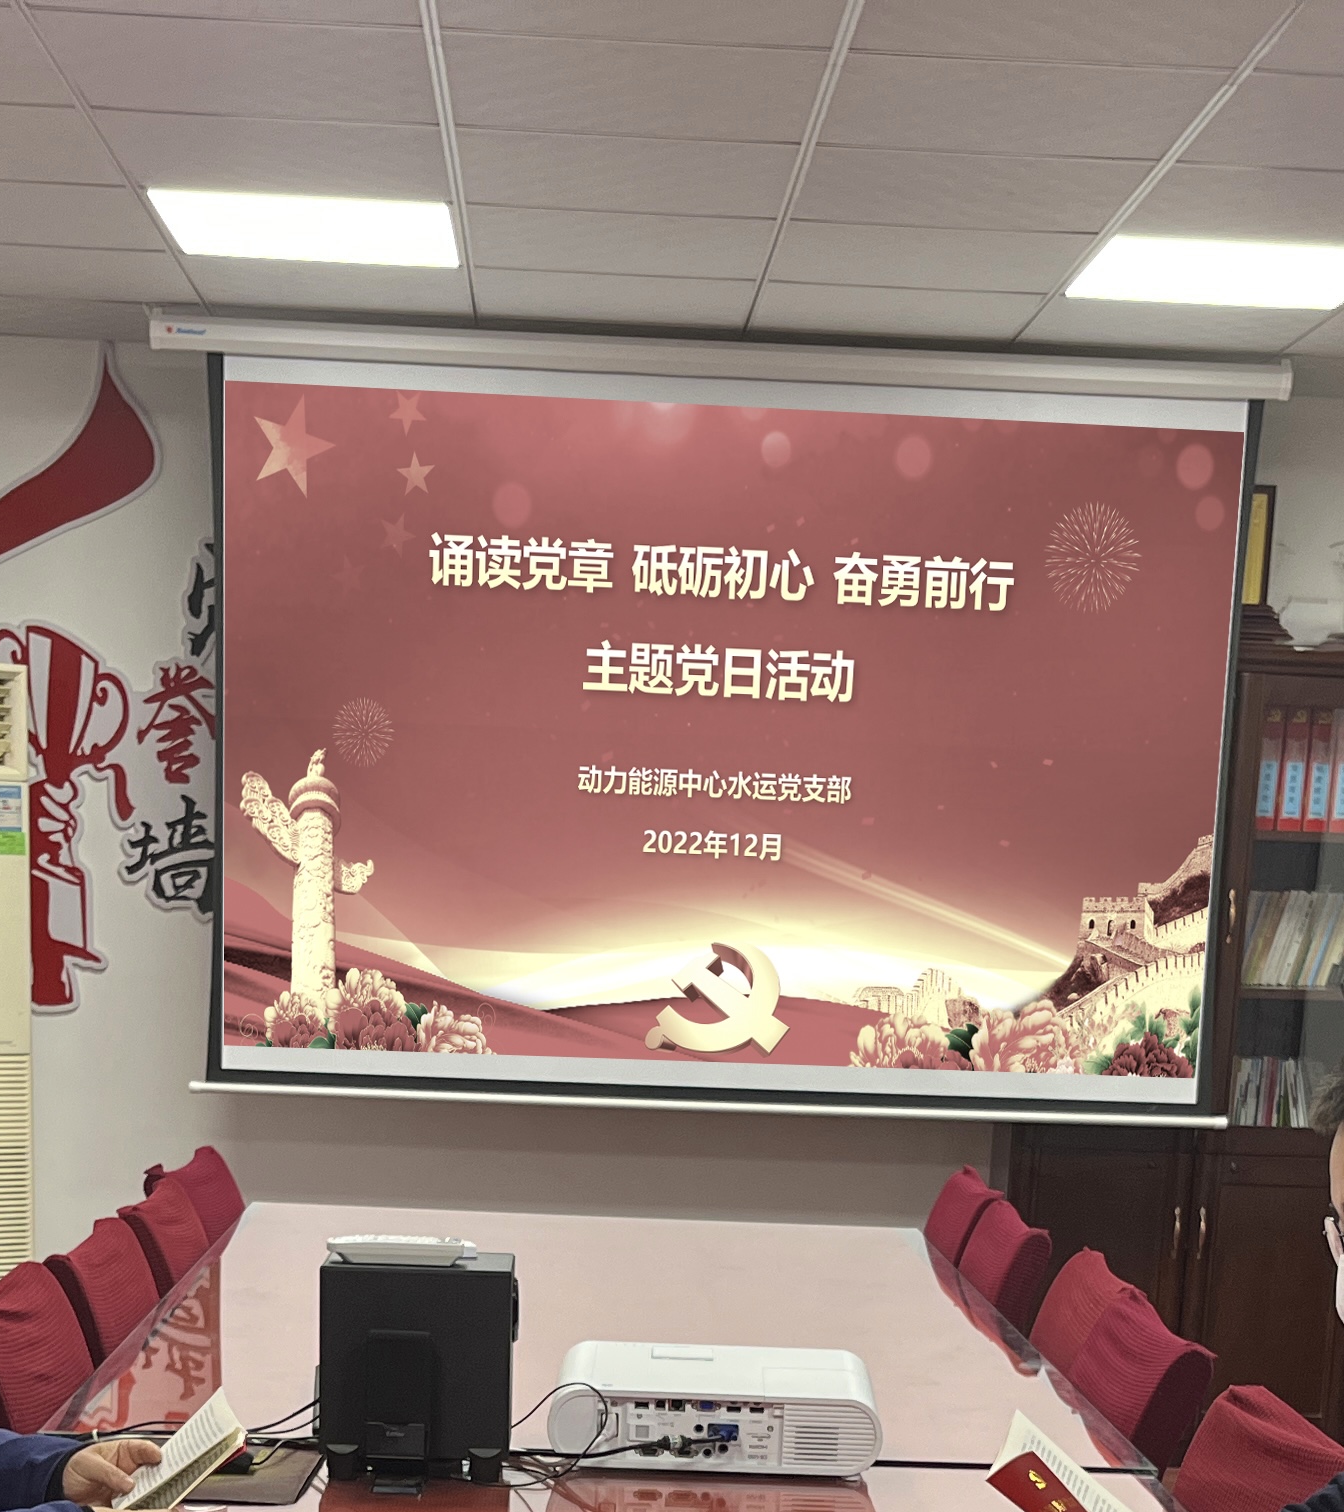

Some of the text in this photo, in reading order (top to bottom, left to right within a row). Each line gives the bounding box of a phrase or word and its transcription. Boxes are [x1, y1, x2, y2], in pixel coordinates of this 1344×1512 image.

[429, 532, 1015, 613] 诵读党章 砥砺初心 奋勇前行
[582, 640, 856, 704] 主题党日活动
[577, 764, 853, 805] 动力能源中心水运党支部
[642, 828, 784, 863] 2022年12月
